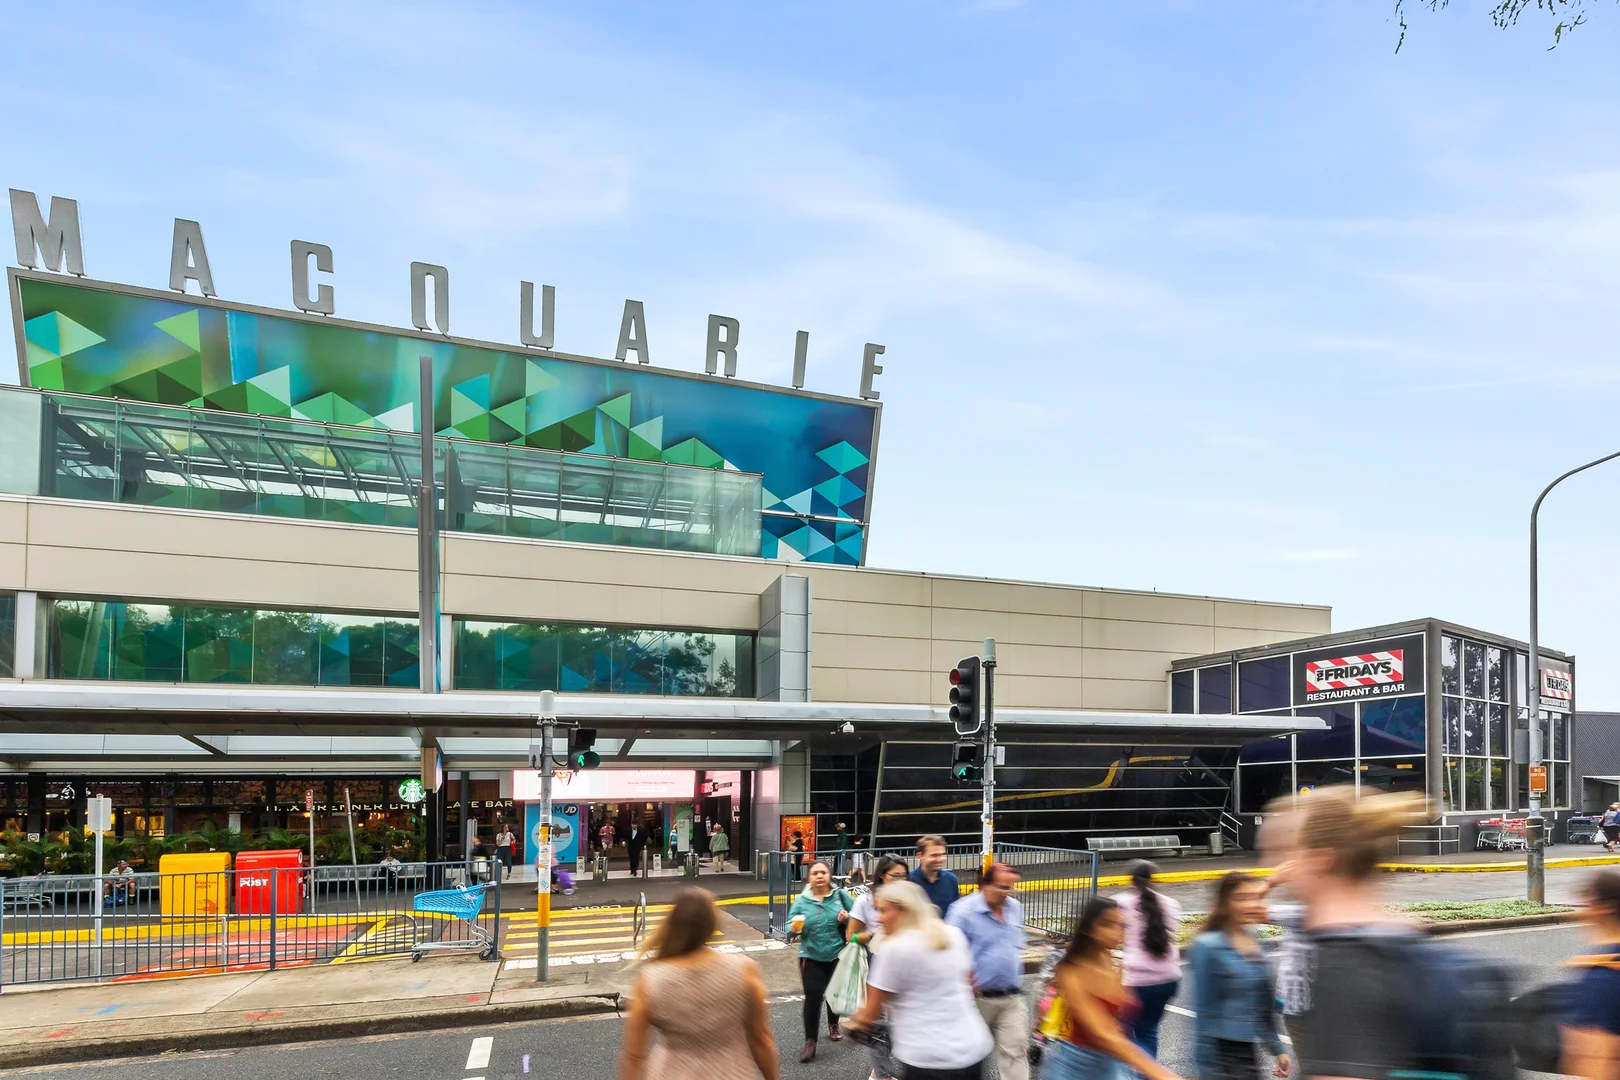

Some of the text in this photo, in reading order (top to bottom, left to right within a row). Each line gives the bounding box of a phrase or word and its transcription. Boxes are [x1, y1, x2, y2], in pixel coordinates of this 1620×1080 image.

[9, 188, 886, 400] MACQUARIE
[1325, 661, 1392, 681] FRIDAYS
[1306, 683, 1405, 702] RESTAURANT & BAR
[485, 800, 513, 808] BAR
[565, 806, 577, 814] JD
[240, 878, 269, 887] POST
